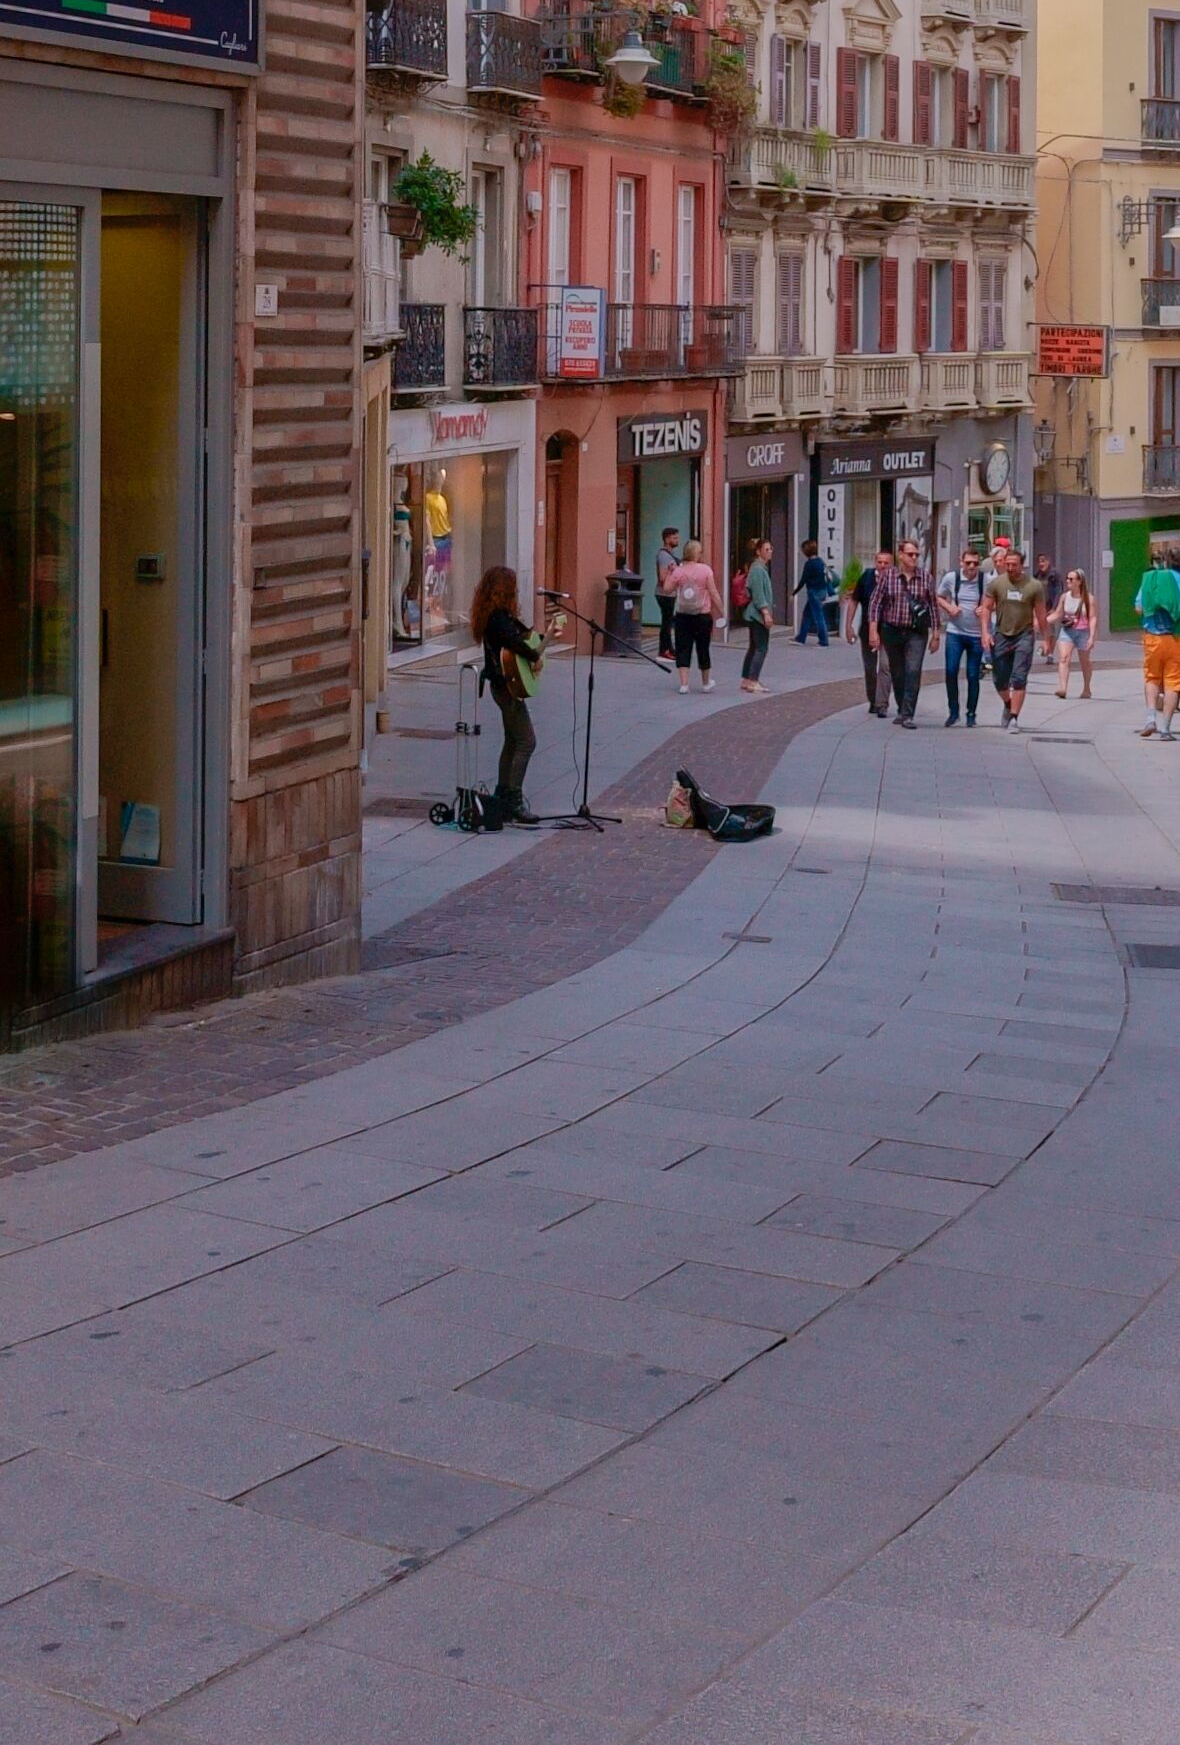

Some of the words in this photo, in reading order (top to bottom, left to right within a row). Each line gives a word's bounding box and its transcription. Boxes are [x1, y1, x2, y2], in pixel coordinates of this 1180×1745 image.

[631, 411, 701, 456] TEZENIS
[830, 457, 871, 475] Arianna
[883, 451, 925, 470] OUTLET
[827, 489, 836, 570] OUTL
